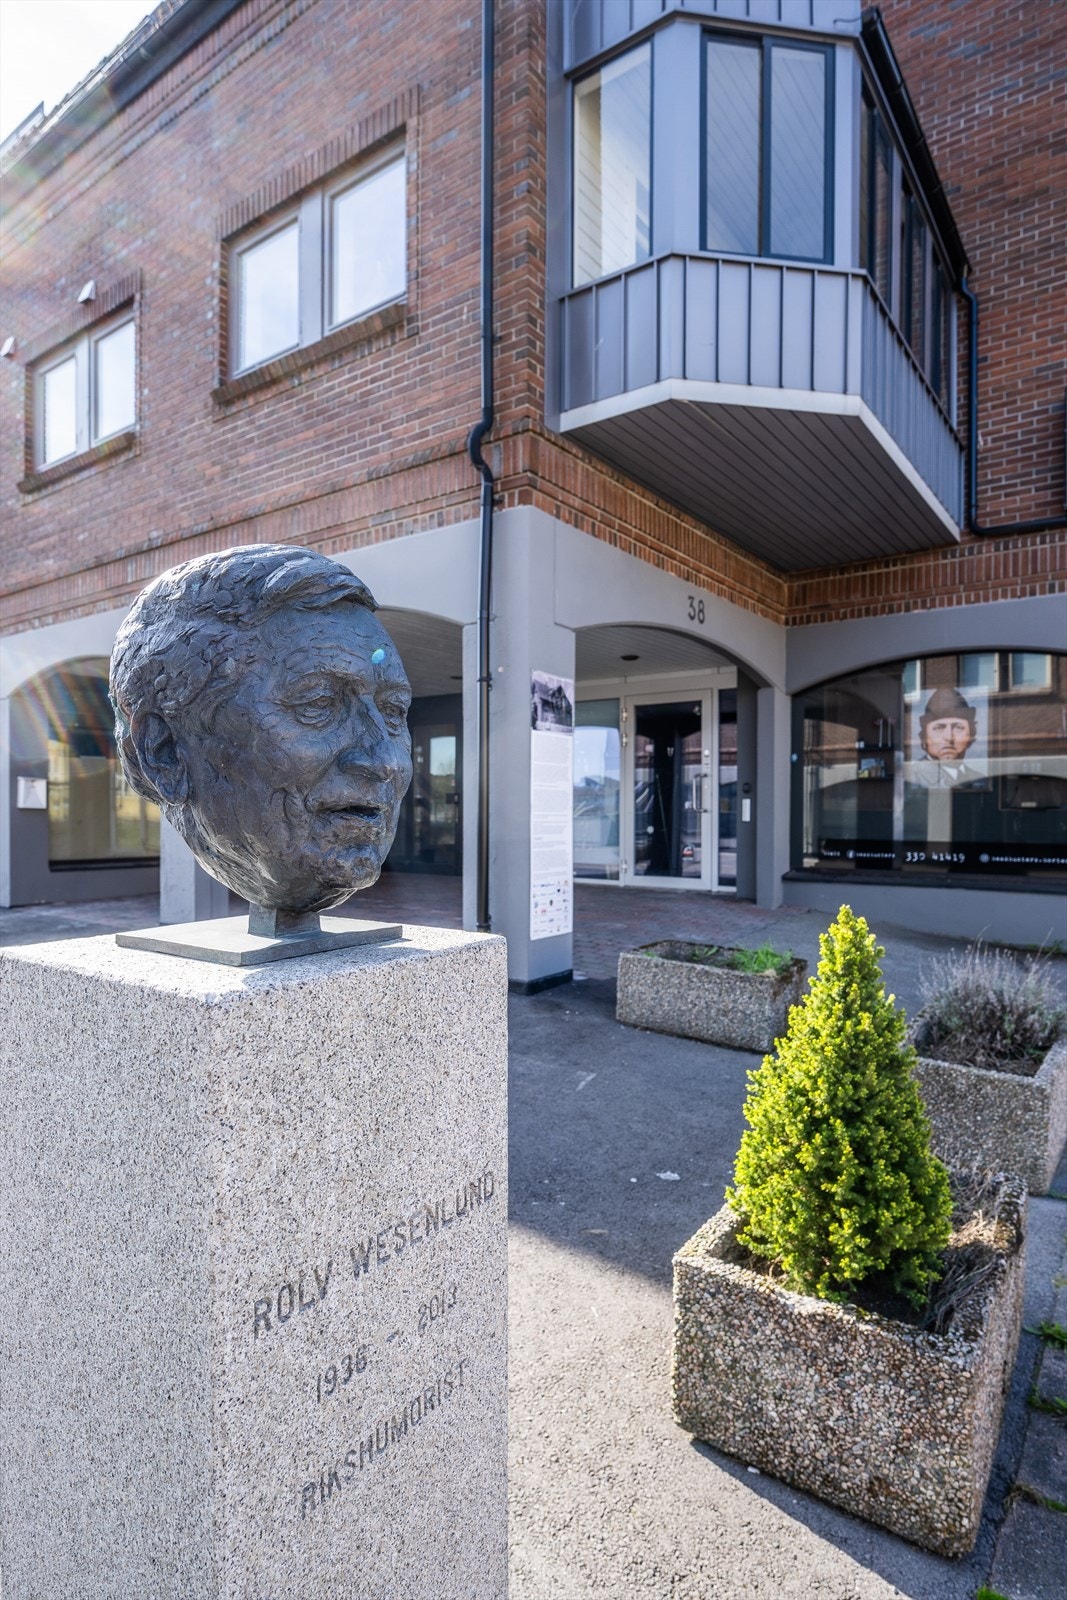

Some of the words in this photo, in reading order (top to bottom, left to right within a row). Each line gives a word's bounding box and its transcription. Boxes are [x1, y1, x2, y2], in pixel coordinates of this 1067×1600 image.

[687, 595, 705, 624] 38
[253, 1259, 334, 1341] ROLV
[350, 1170, 495, 1280] WESENLUND
[316, 1343, 368, 1404] 1936
[300, 1357, 469, 1521] RIKSHUMORIST
